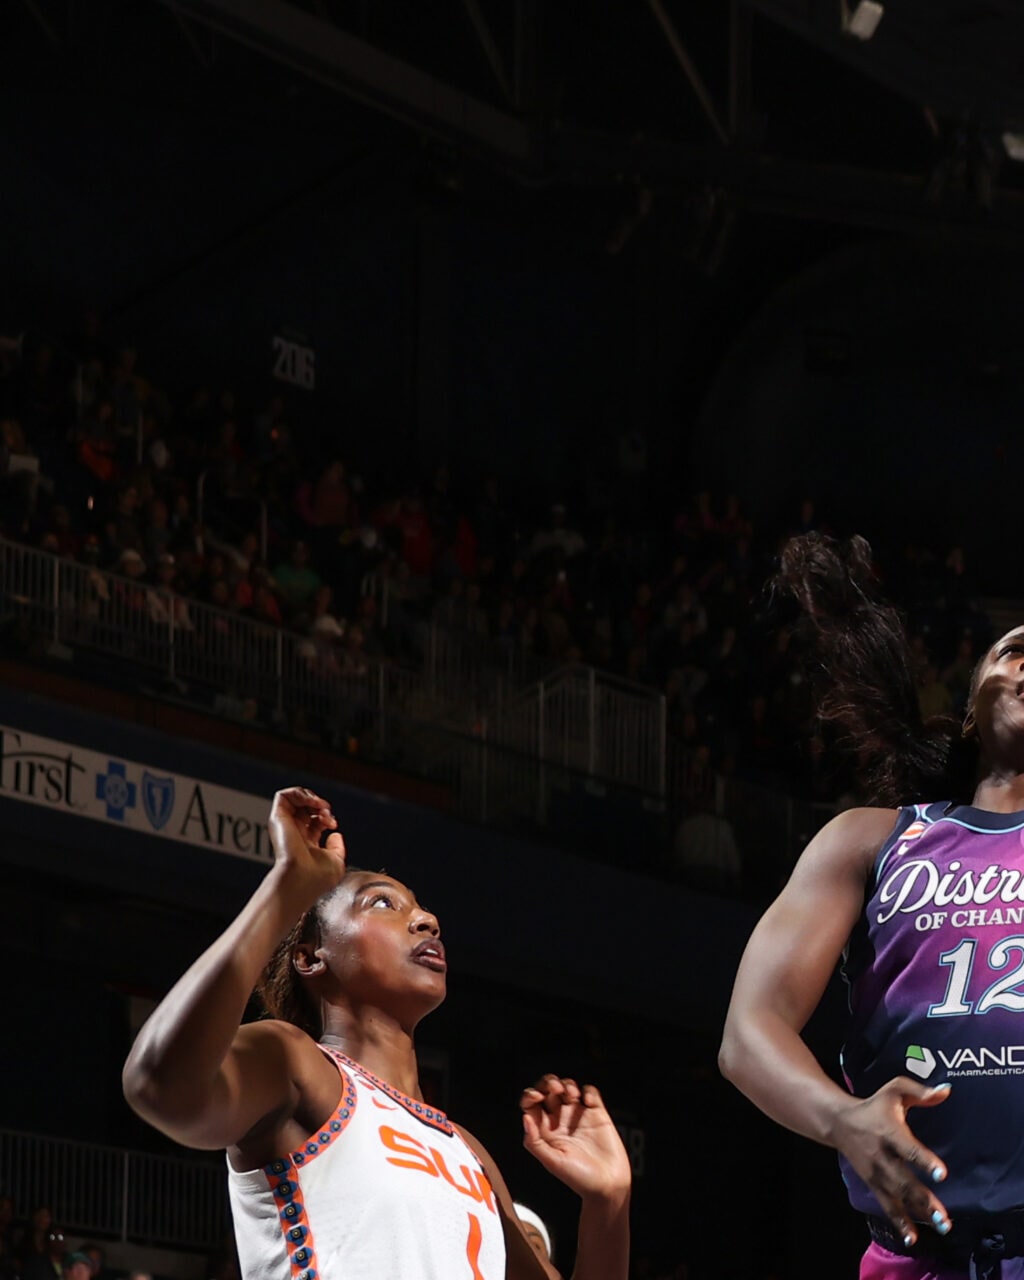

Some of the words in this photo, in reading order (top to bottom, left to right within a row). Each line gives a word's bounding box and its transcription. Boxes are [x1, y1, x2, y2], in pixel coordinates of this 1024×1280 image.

[271, 335, 316, 391] 206
[180, 784, 275, 857] Aren
[915, 911, 948, 932] OF
